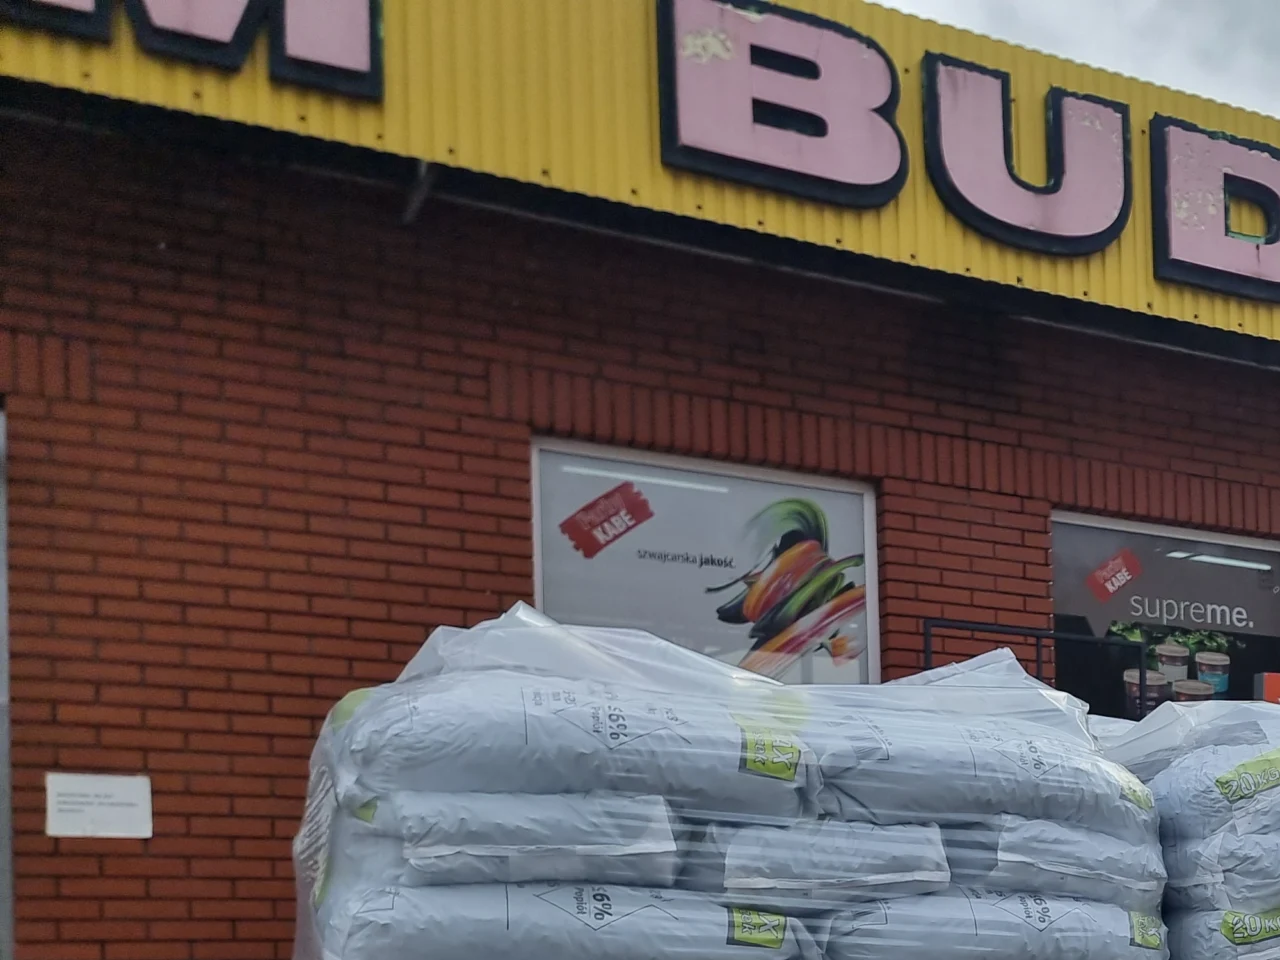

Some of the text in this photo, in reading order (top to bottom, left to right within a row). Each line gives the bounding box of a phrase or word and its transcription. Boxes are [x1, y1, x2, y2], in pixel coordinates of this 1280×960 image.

[593, 509, 636, 544] KABE
[637, 549, 697, 564] szwajcarska
[1104, 568, 1133, 594] KABE
[1130, 595, 1254, 628] supreme.
